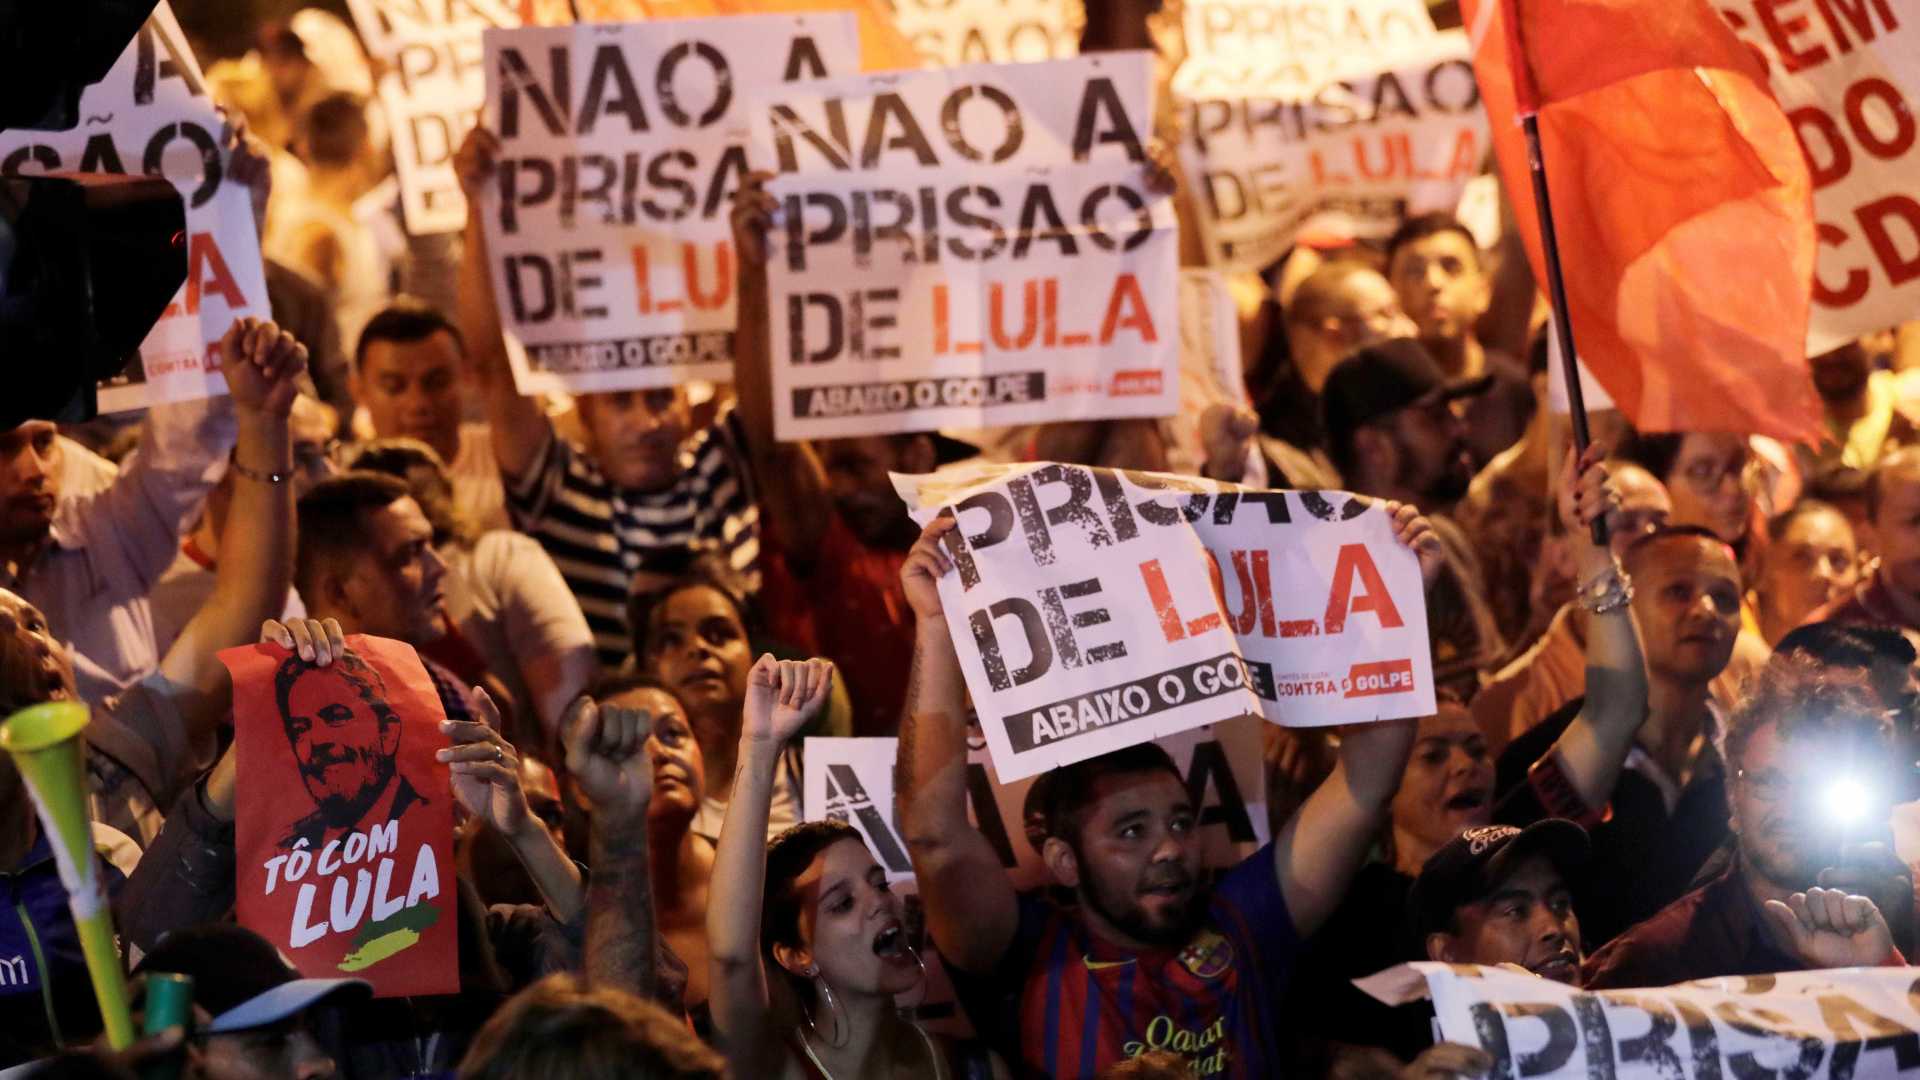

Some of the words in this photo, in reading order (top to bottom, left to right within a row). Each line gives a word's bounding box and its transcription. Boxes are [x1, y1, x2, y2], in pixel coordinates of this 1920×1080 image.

[499, 26, 733, 138] NÃO
[769, 77, 1024, 173] NÃO
[785, 165, 1152, 272] PRISÃO
[1204, 163, 1286, 220] DE
[1309, 127, 1478, 187] LULA
[504, 249, 609, 324] DE
[788, 287, 902, 365] DE
[932, 272, 1158, 354] LULA
[808, 377, 907, 417] ABAIXO
[913, 376, 939, 407] O
[941, 370, 1030, 408] GOLPE
[969, 577, 1128, 693] DE
[1138, 543, 1405, 643] LULA
[1032, 685, 1151, 745] ABAIXO
[1157, 674, 1187, 705] O
[1192, 656, 1266, 697] GOE
[1355, 670, 1413, 692] GOLPE
[264, 837, 312, 895] TÔ
[317, 819, 398, 876] COM
[290, 843, 440, 948] LULA
[1468, 984, 1920, 1080] PRISÃ
